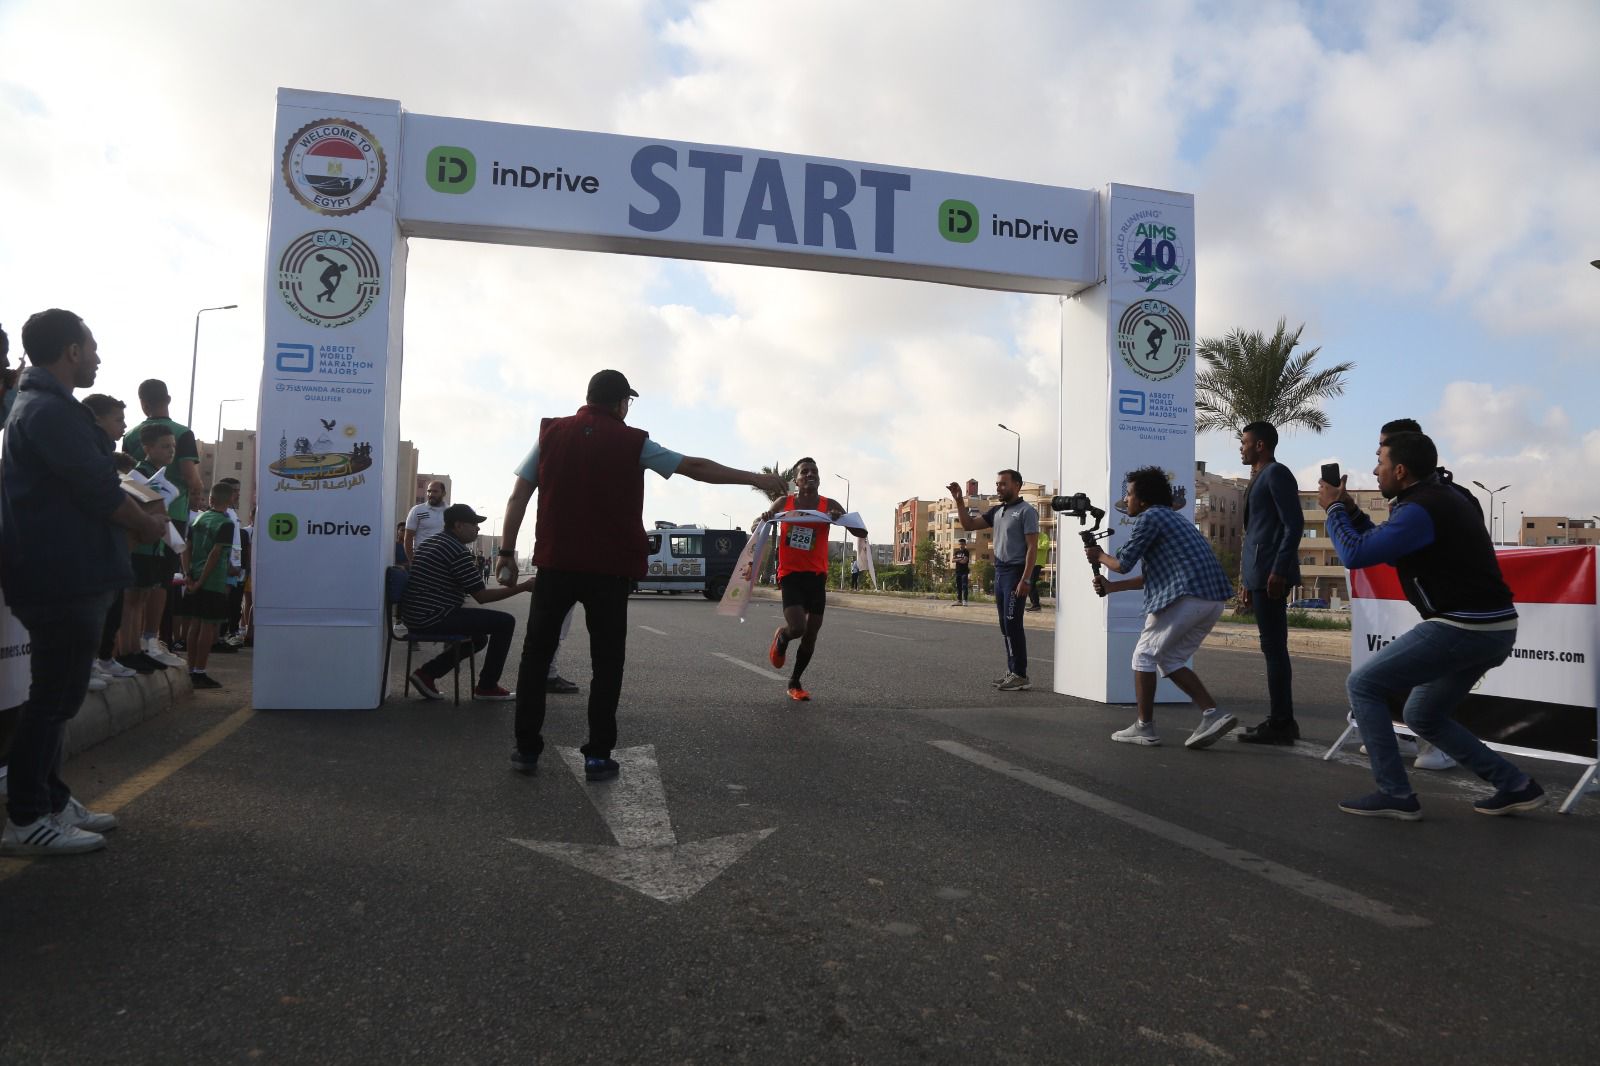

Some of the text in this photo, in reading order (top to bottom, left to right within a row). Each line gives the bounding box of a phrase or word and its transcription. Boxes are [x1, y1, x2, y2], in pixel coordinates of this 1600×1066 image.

[299, 127, 372, 153] WELCOME TO
[492, 161, 600, 194] inDrive
[313, 194, 352, 208] EGYPT
[628, 144, 911, 254] START
[992, 213, 1079, 245] inDrive
[1135, 223, 1176, 241] AIMS
[1116, 233, 1129, 274] WORLD
[1133, 238, 1176, 272] 40
[319, 345, 356, 353] ABBOTT
[319, 352, 353, 360] WORLD
[319, 360, 374, 369] MARATHON
[319, 368, 358, 376] MAJORS
[346, 387, 372, 395] GROUP
[1149, 392, 1175, 400] ABBOTT
[304, 394, 342, 402] QUALIFIER
[1149, 405, 1188, 413] MARATHON
[307, 520, 372, 536] inDrive
[792, 533, 810, 544] 228
[648, 563, 702, 576] OLICE
